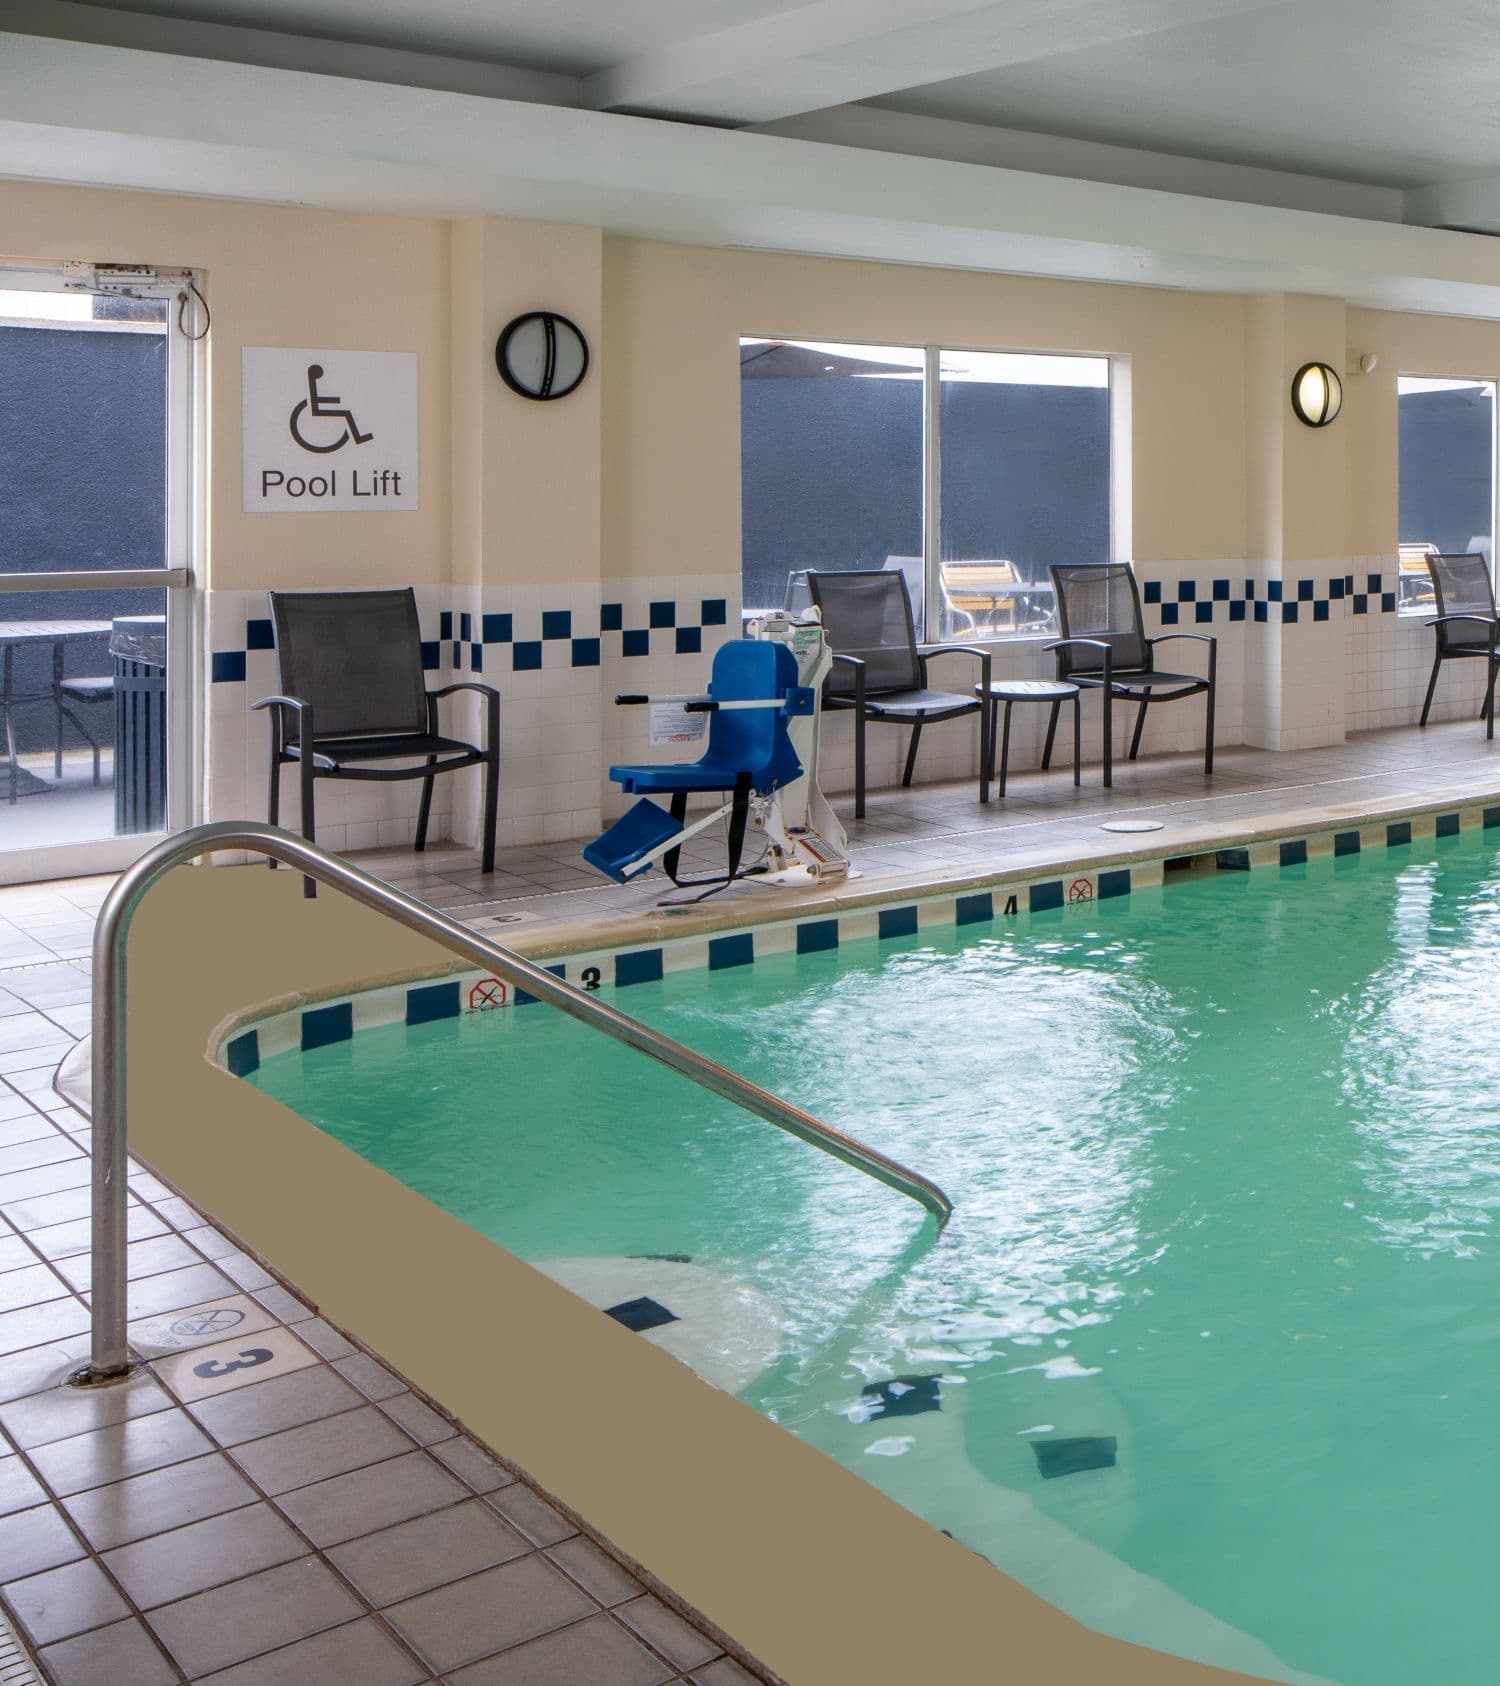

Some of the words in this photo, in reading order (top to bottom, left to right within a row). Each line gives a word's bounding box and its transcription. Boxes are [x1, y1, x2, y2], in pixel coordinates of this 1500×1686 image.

[262, 469, 336, 498] Pool
[353, 469, 402, 497] Lift
[1003, 895, 1018, 915] 4
[580, 966, 601, 991] 3
[193, 1348, 274, 1379] 3
